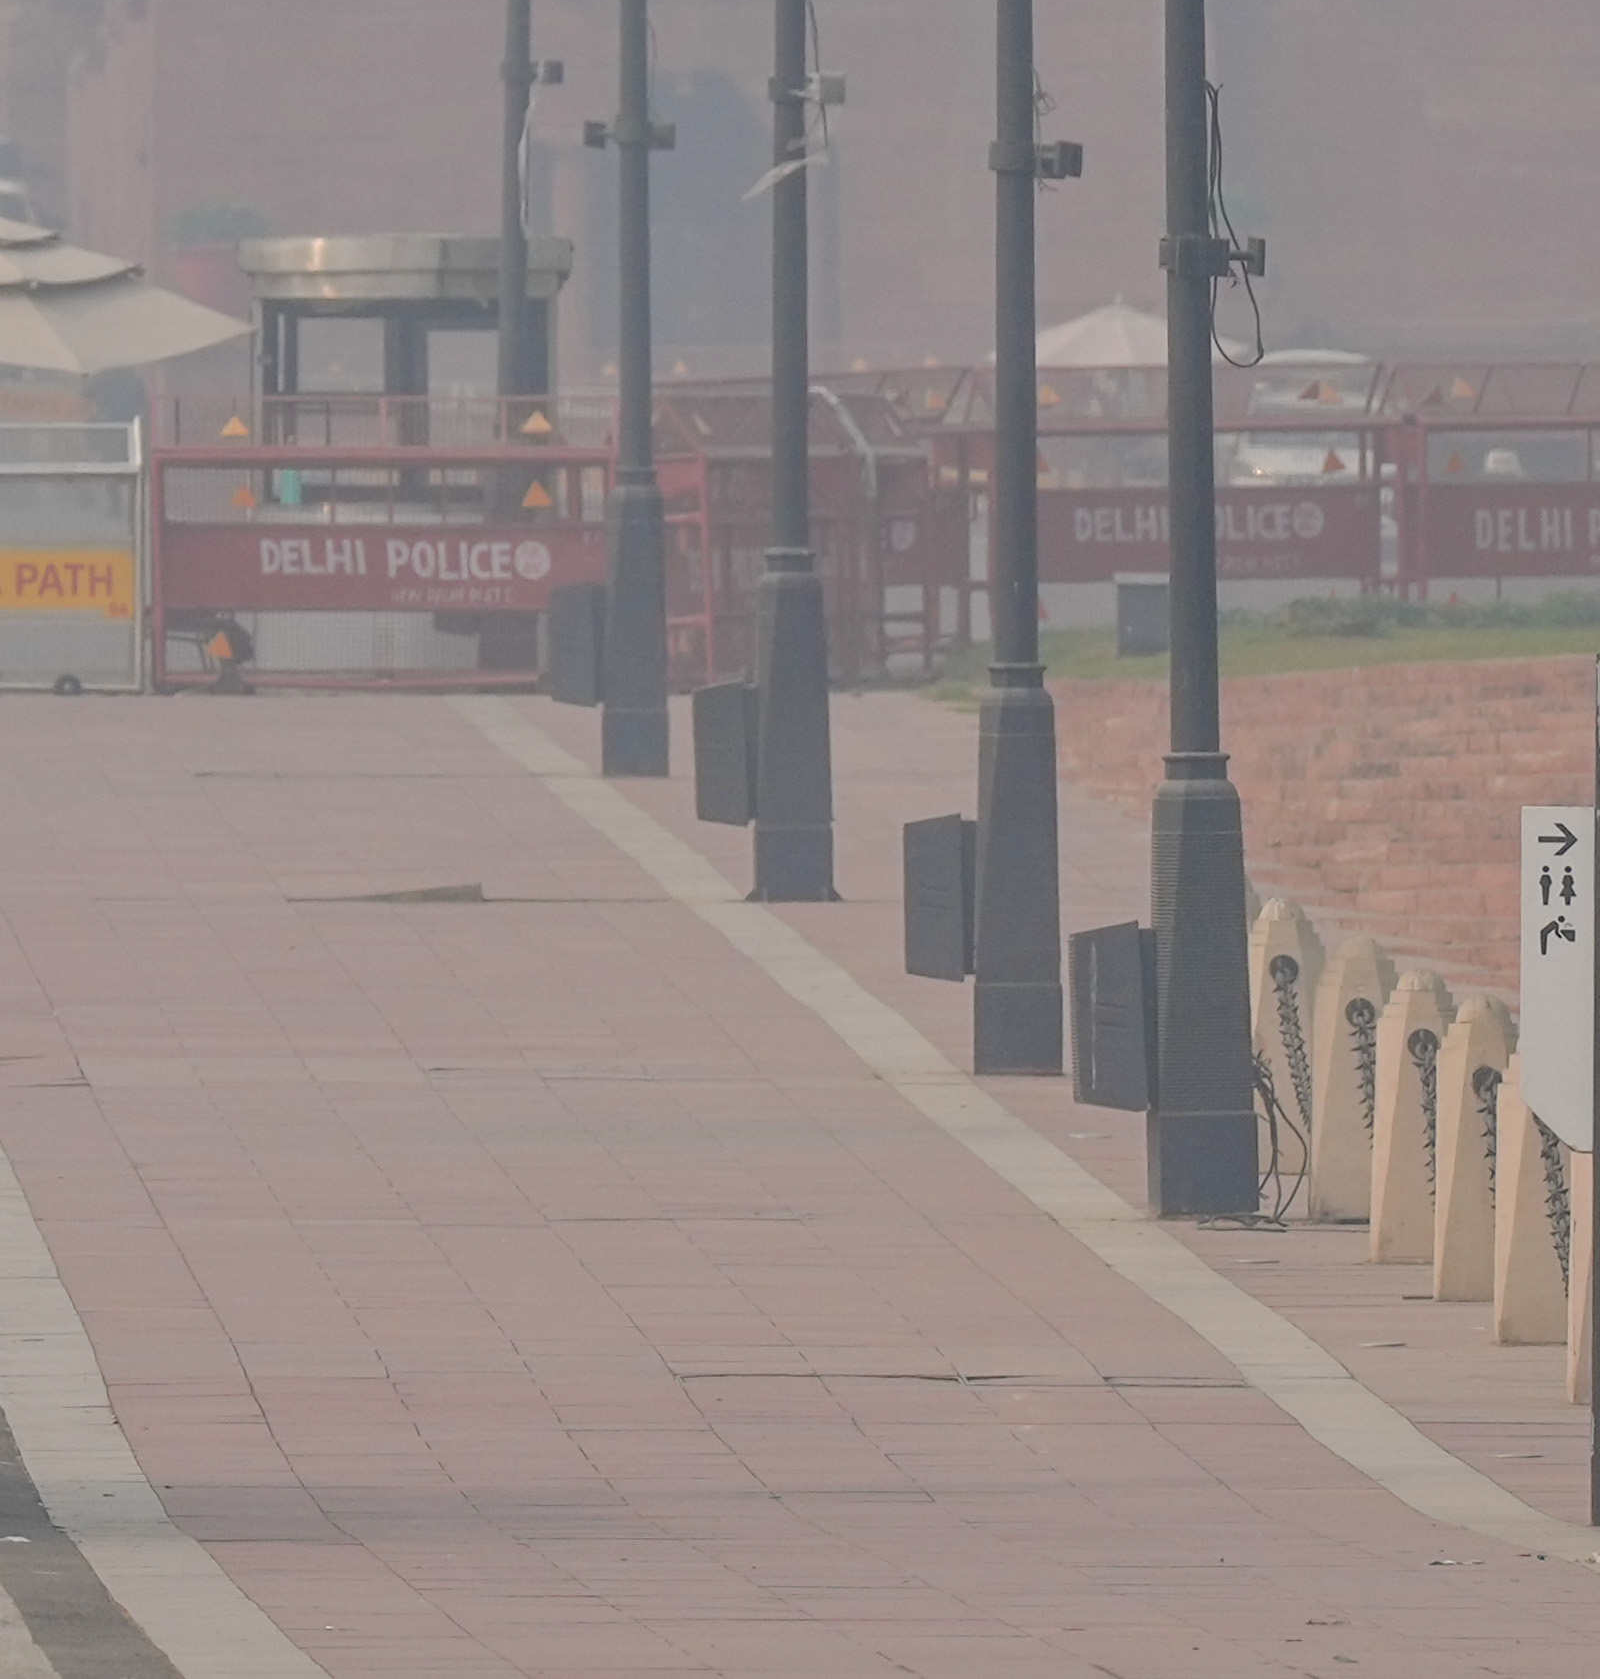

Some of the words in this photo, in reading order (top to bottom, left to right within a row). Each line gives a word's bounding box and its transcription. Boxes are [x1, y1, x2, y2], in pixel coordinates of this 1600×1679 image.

[1074, 505, 1169, 542] DELHI
[1474, 507, 1574, 552] DELHI
[259, 538, 367, 576] DELHI
[386, 539, 513, 582] POLICE
[14, 564, 115, 598] PATH
